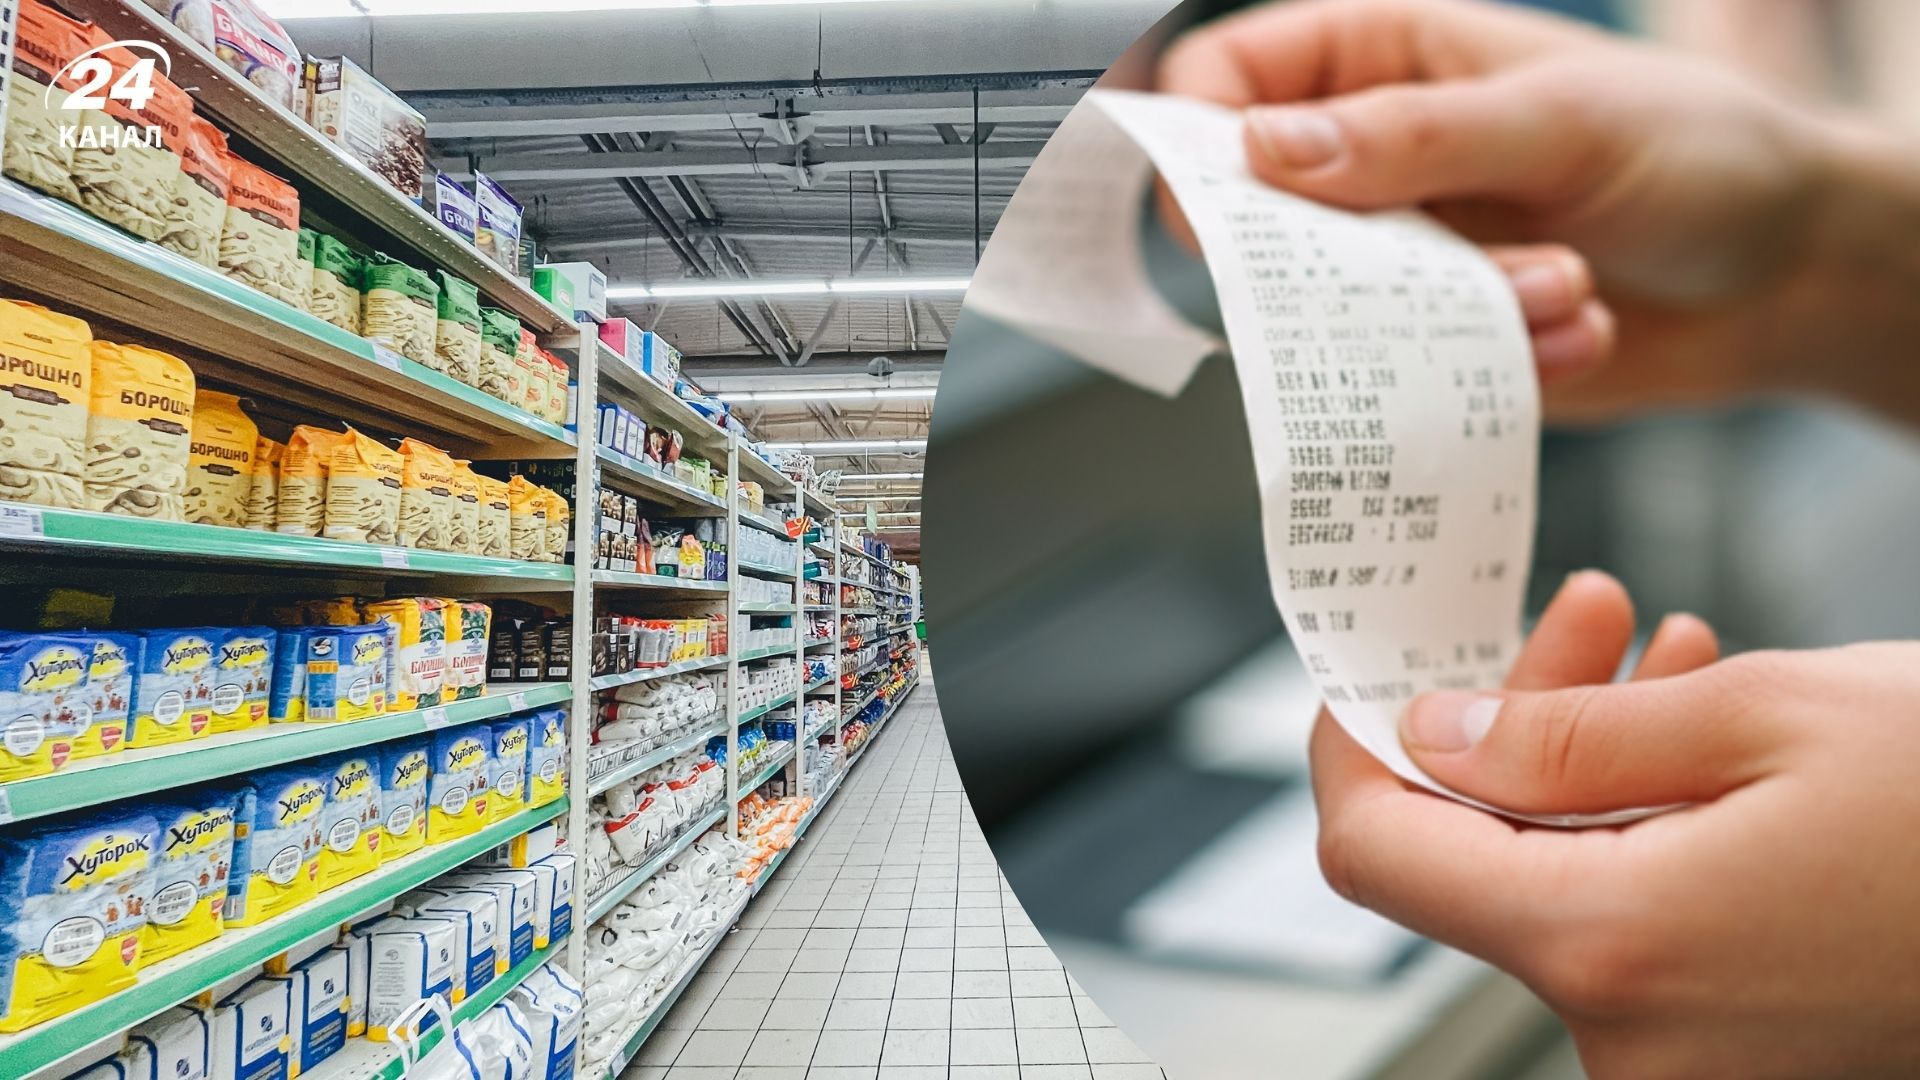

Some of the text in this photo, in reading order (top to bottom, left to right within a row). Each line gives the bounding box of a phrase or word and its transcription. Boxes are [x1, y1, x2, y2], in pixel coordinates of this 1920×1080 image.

[190, 441, 250, 463] БОРОШНО
[165, 642, 215, 668] Хуторок
[219, 641, 269, 665] Хуторок
[166, 806, 236, 852] Хуторок
[60, 834, 151, 885] Хуторок
